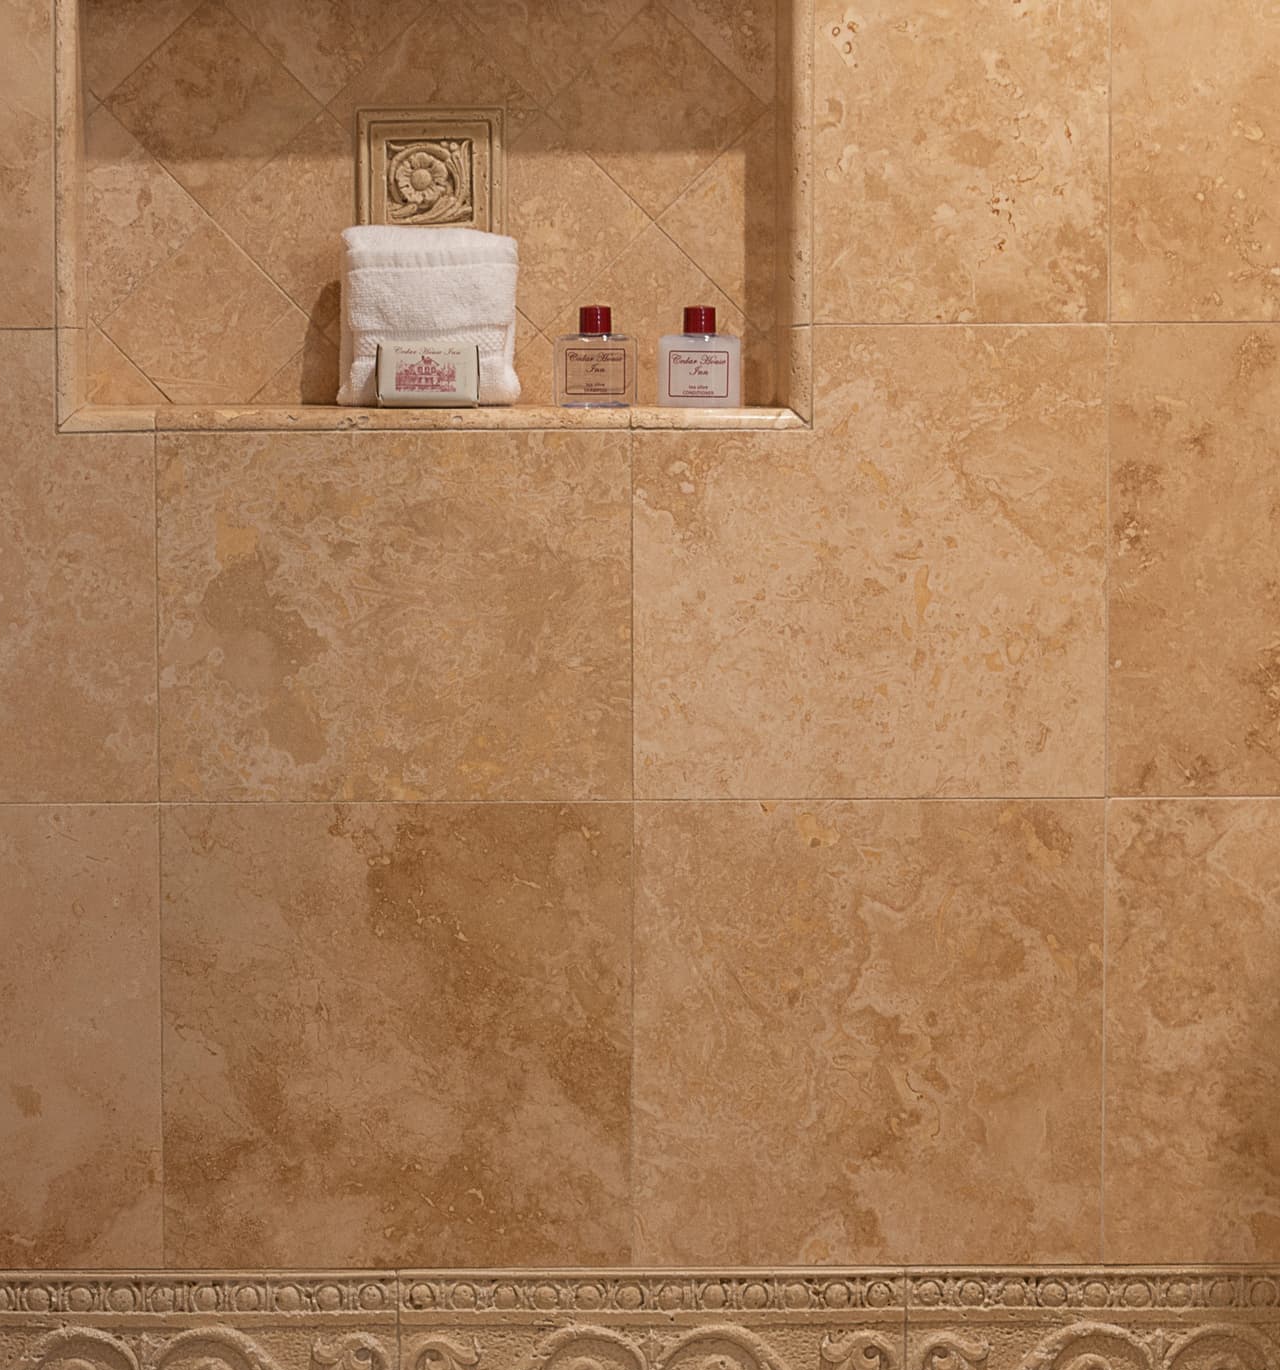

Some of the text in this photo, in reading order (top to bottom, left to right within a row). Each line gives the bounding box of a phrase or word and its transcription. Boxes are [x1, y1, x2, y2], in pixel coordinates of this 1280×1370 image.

[568, 352, 622, 361] Cedar House
[672, 354, 726, 365] Cedar House
[585, 363, 605, 372] Inn
[688, 366, 708, 375] Inn
